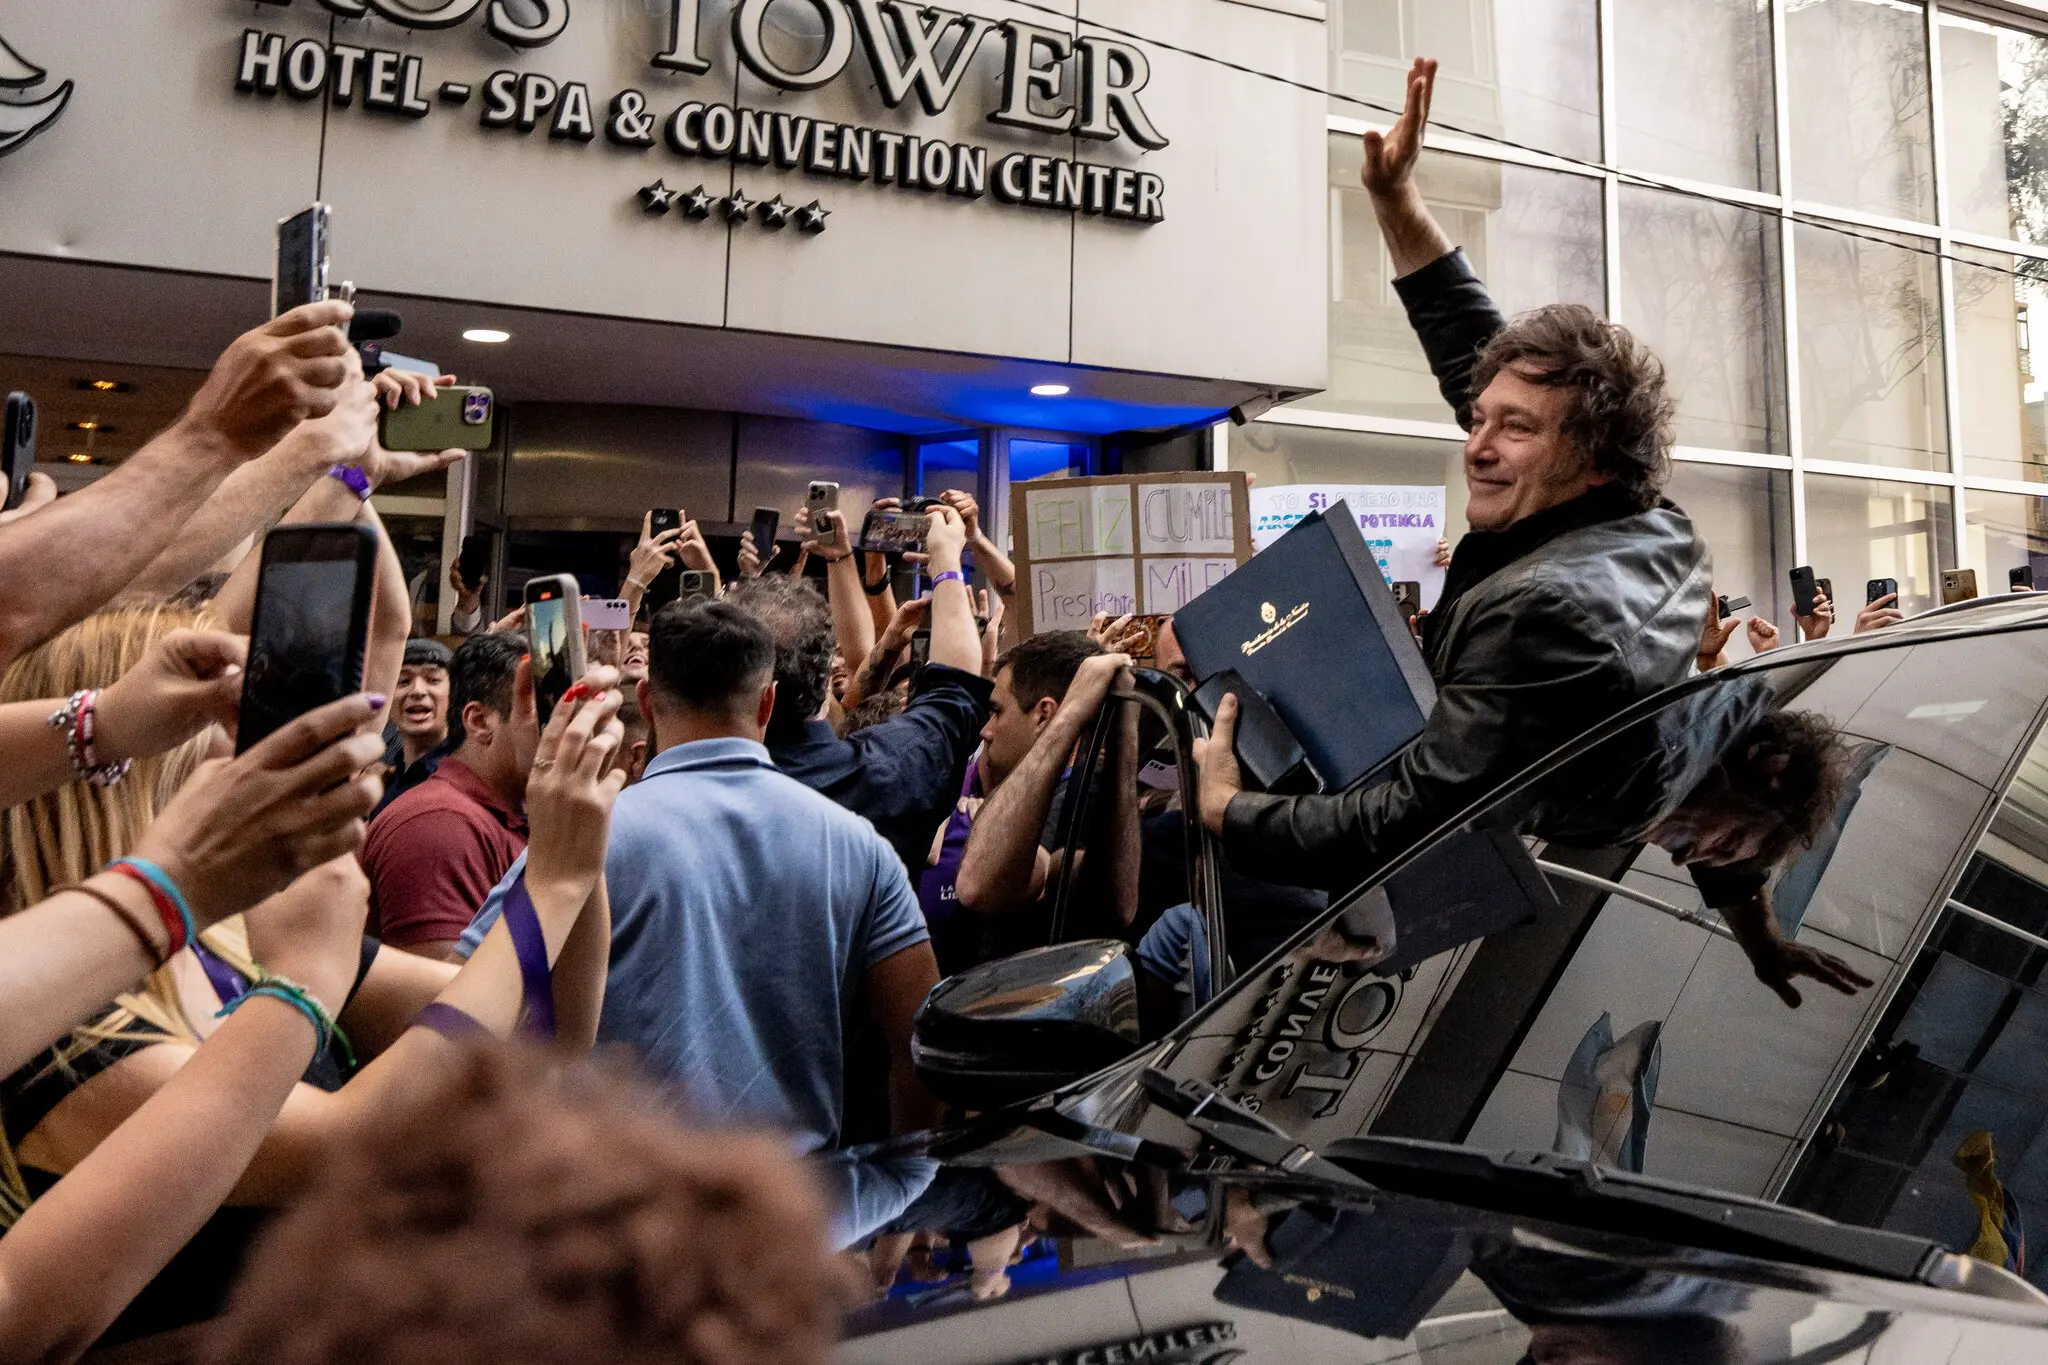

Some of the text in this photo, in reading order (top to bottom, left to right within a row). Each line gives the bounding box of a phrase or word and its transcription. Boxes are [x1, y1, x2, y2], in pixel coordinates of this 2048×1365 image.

[238, 29, 429, 116] HOTEL
[483, 70, 594, 141] SPA
[607, 89, 655, 145] &
[668, 101, 987, 197] CONVENTION
[995, 152, 1165, 223] CENTER
[1034, 488, 1233, 556] FELIZ CUMPLE
[1270, 493, 1300, 510] YO
[1403, 491, 1439, 508] UNA
[1038, 569, 1136, 624] Presidente
